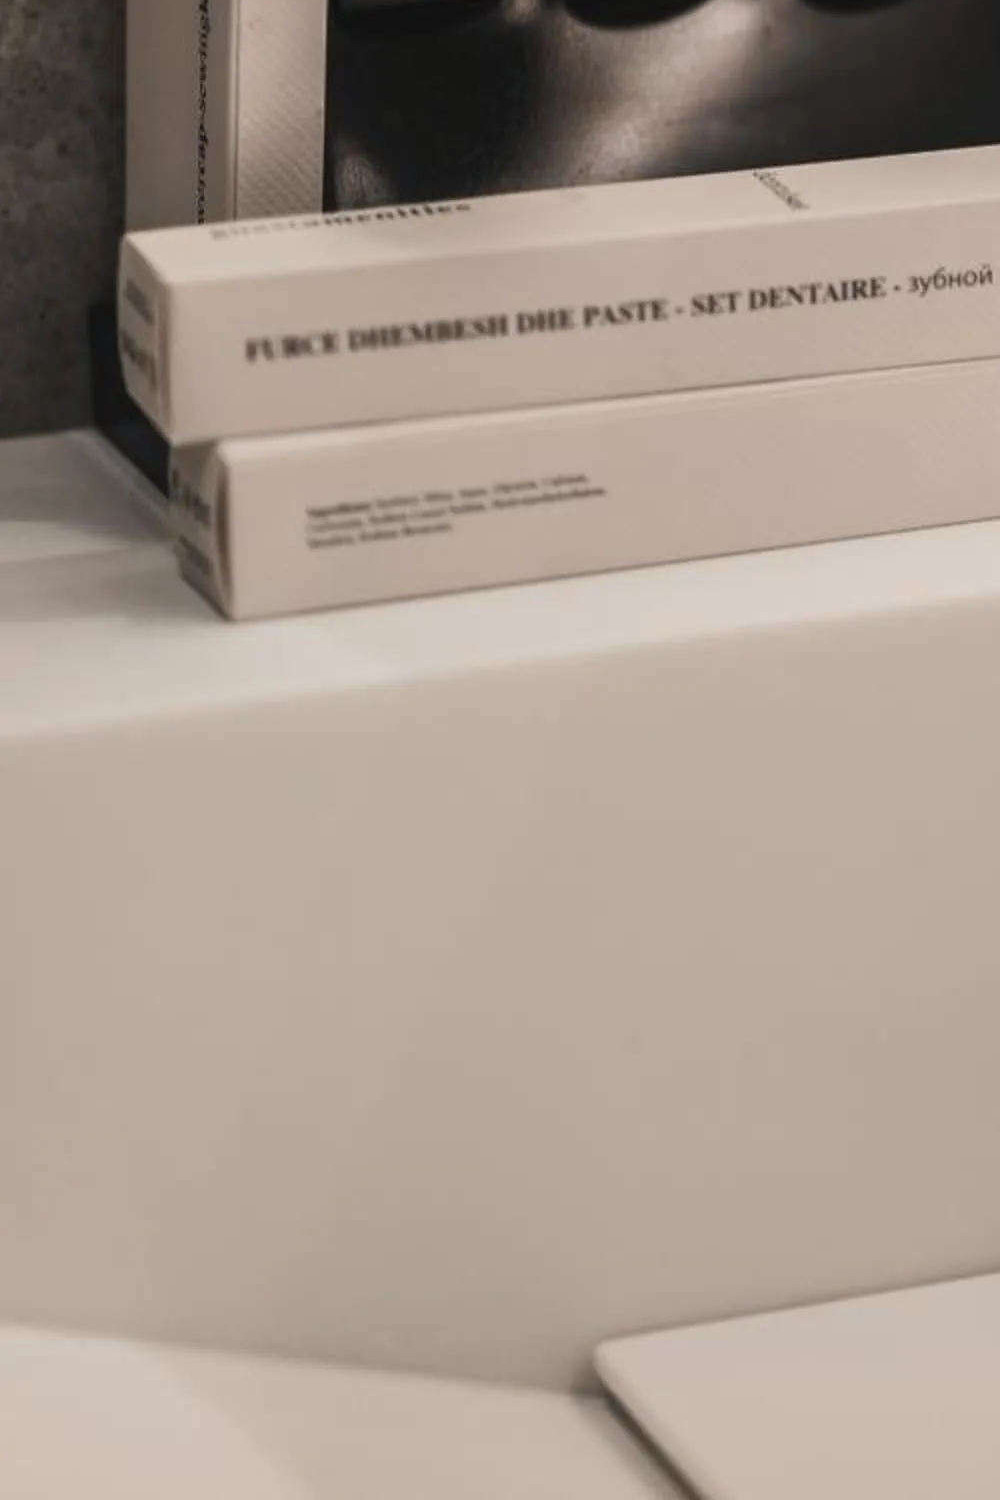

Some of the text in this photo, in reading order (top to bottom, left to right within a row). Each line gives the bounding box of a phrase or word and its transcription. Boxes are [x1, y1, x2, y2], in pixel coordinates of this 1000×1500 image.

[582, 297, 669, 329] PASTE
[690, 290, 742, 318] SET
[747, 276, 888, 314] DENTAIRE
[908, 262, 994, 298] зубной
